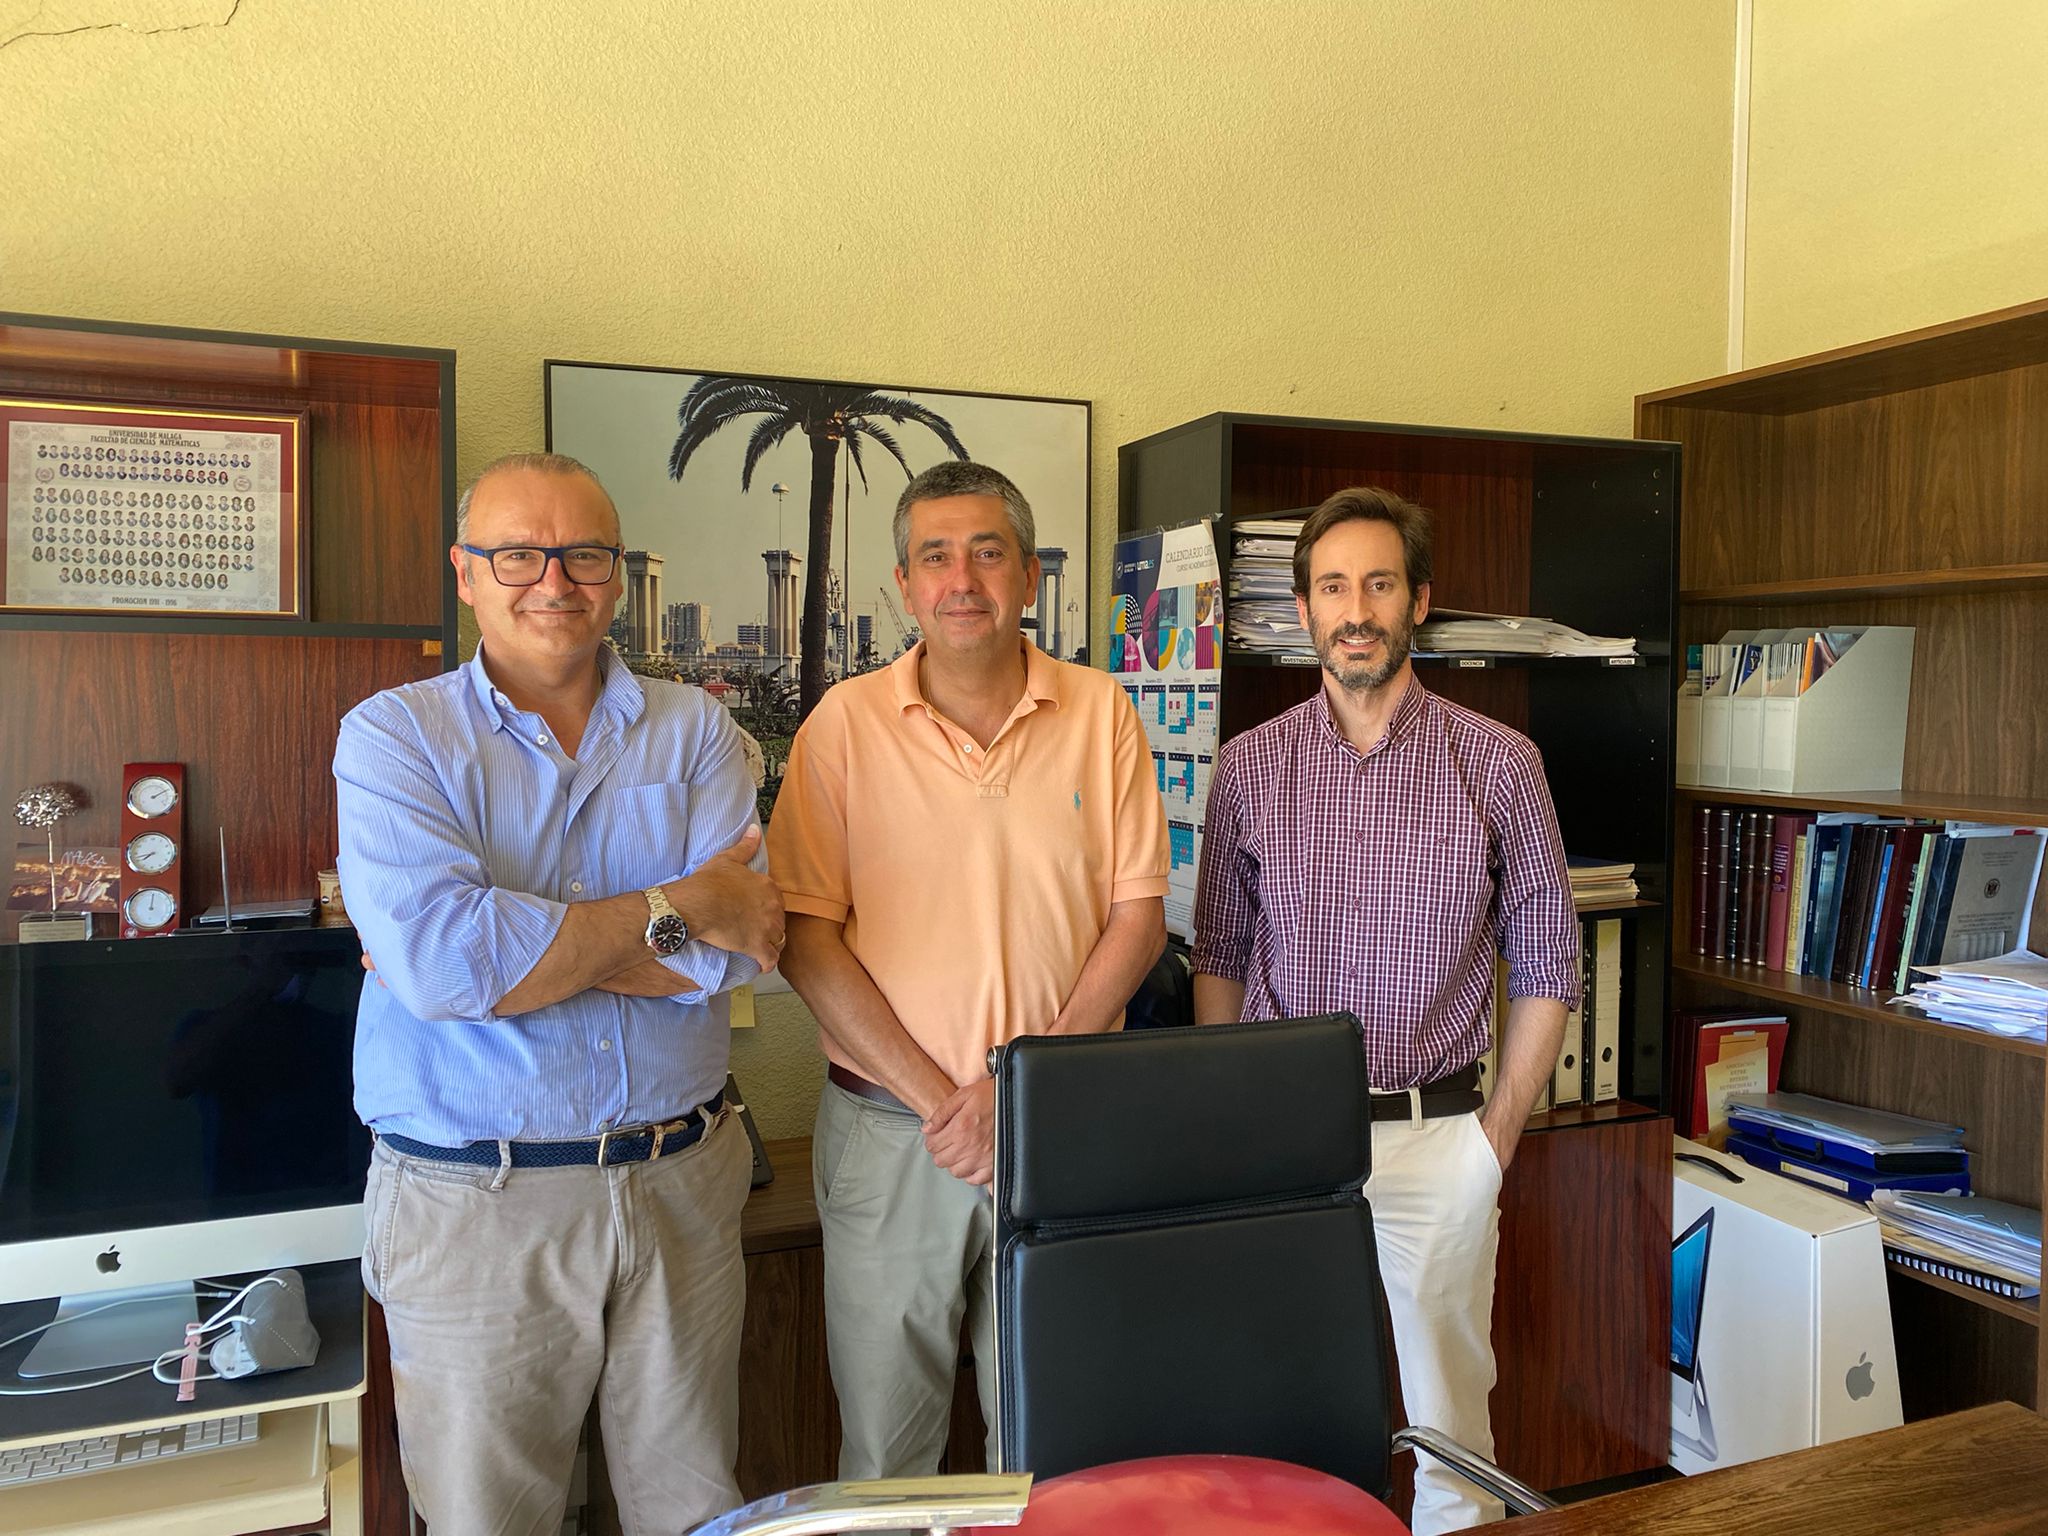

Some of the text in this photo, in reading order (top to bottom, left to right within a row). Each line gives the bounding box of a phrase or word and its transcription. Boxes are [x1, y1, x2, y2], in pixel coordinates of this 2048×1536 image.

[109, 430, 182, 440] UNIVERSIDAD DE MALAGA
[90, 435, 119, 443] FACULTAD
[159, 439, 200, 447] MATEMATICAS
[1166, 546, 1203, 563] CALENDARIO
[112, 597, 147, 605] PROMOCION
